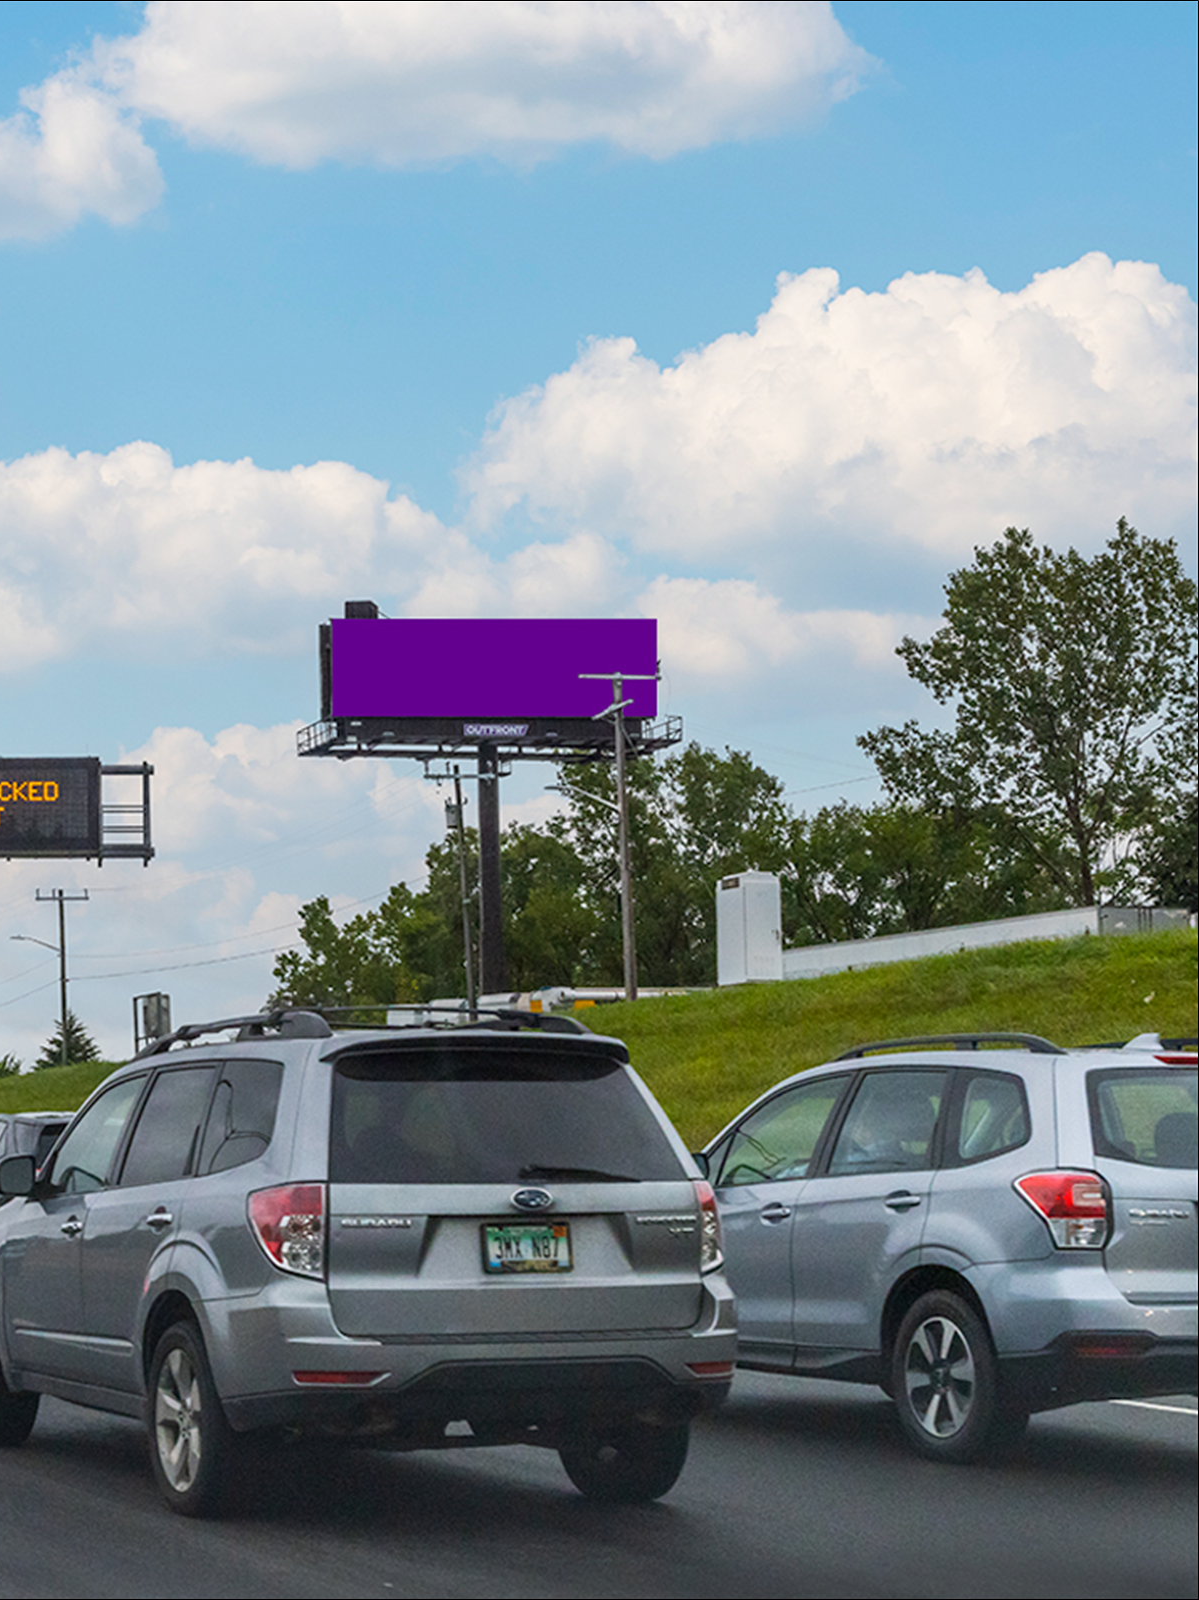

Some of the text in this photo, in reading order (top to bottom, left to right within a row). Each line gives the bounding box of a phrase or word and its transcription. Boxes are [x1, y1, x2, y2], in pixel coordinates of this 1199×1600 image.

[466, 724, 525, 736] OUTFRONT
[341, 1217, 412, 1228] SUBARU
[494, 1235, 559, 1259] 3MX N87
